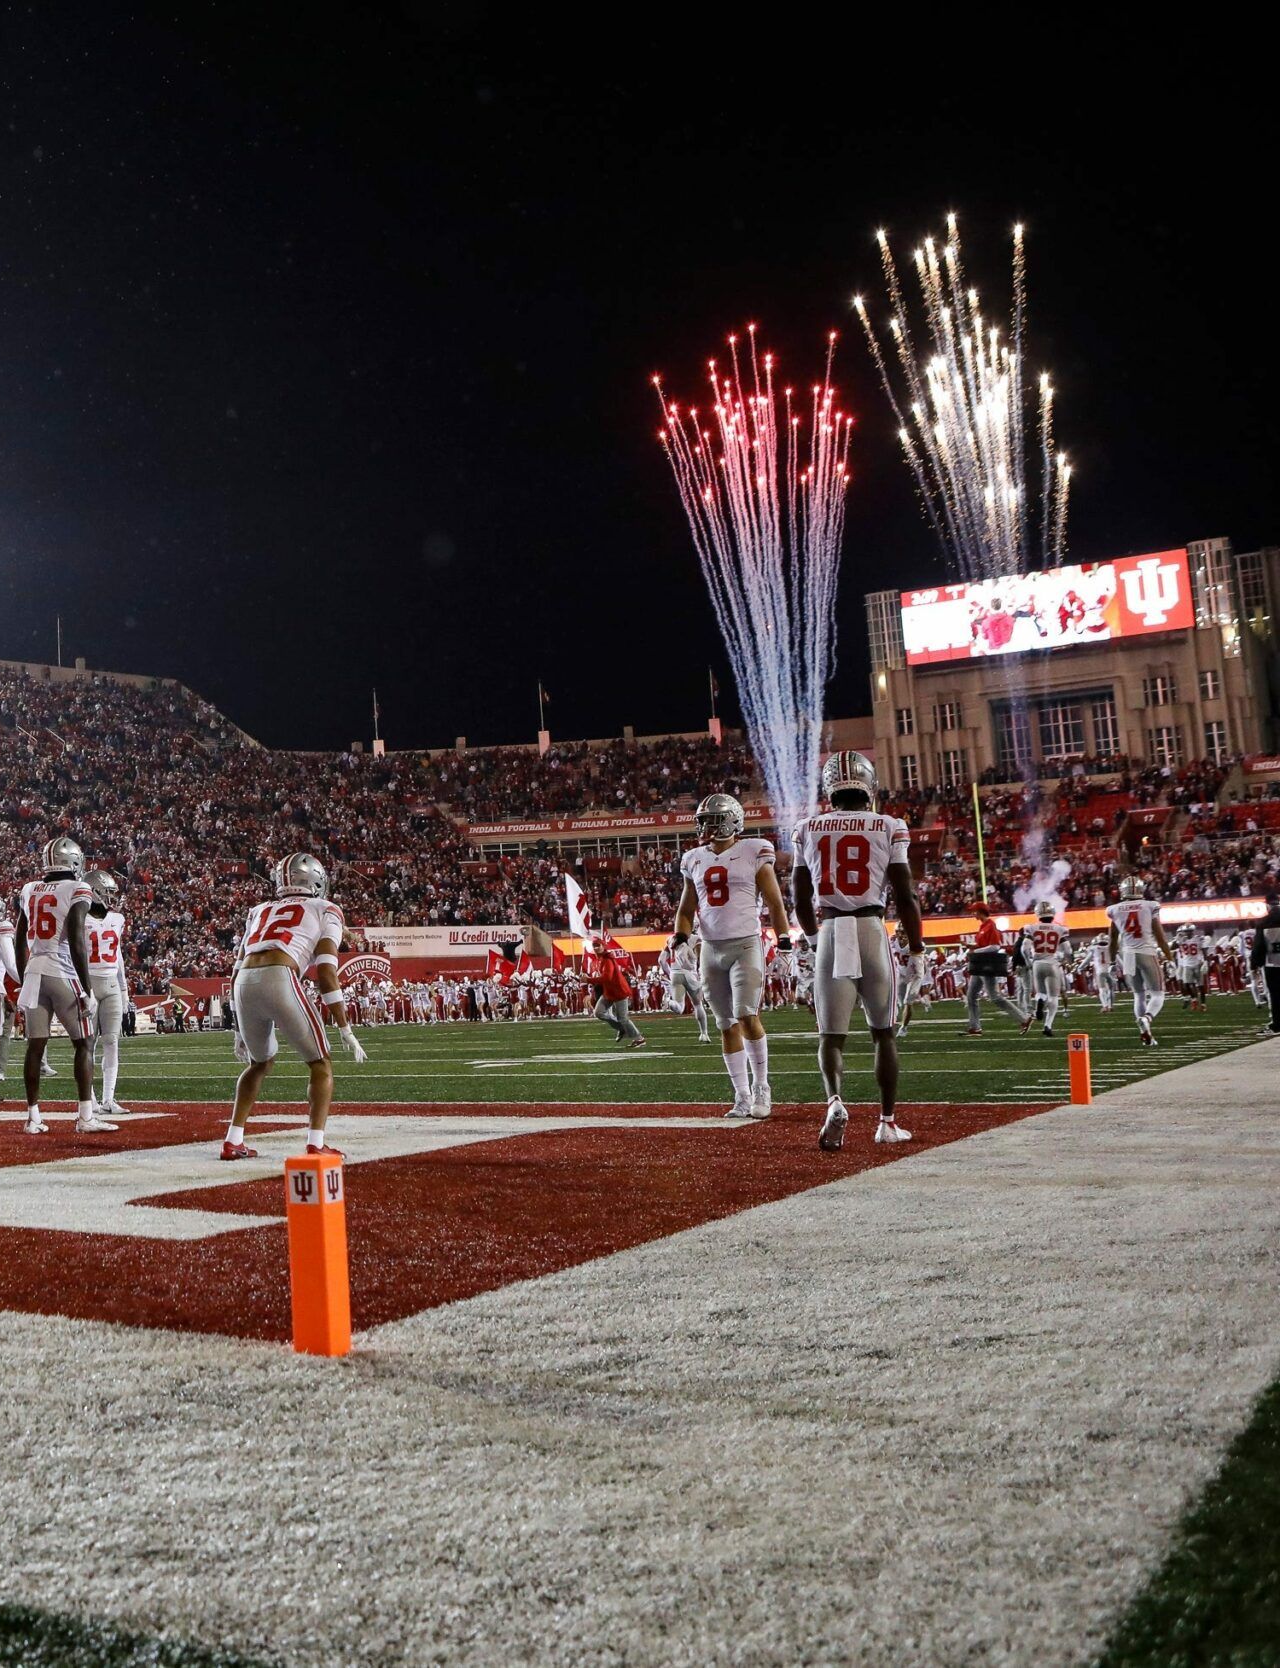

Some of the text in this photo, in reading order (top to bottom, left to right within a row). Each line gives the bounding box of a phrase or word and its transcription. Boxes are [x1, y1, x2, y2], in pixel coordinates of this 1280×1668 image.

[1120, 558, 1180, 627] IU
[468, 825, 506, 834] INDIANA
[508, 823, 552, 832] FOOTBALL
[571, 819, 609, 829] INDIANA
[611, 816, 656, 827] FOOTBALL
[676, 814, 696, 823] INDI
[808, 818, 866, 832] HARRISON
[1144, 814, 1155, 822] 17
[817, 834, 871, 896] 18
[33, 883, 57, 892] WATTS
[704, 865, 730, 907] 8
[27, 894, 58, 940] 16
[246, 904, 305, 946] 12
[1124, 911, 1143, 938] 4
[89, 930, 119, 963] 13
[449, 930, 518, 943] IU Credit Union
[1033, 930, 1059, 954] 29
[344, 959, 392, 977] UNIVERSIT
[1072, 1039, 1082, 1050] IU
[293, 1171, 313, 1202] IU
[326, 1169, 340, 1200] IU
